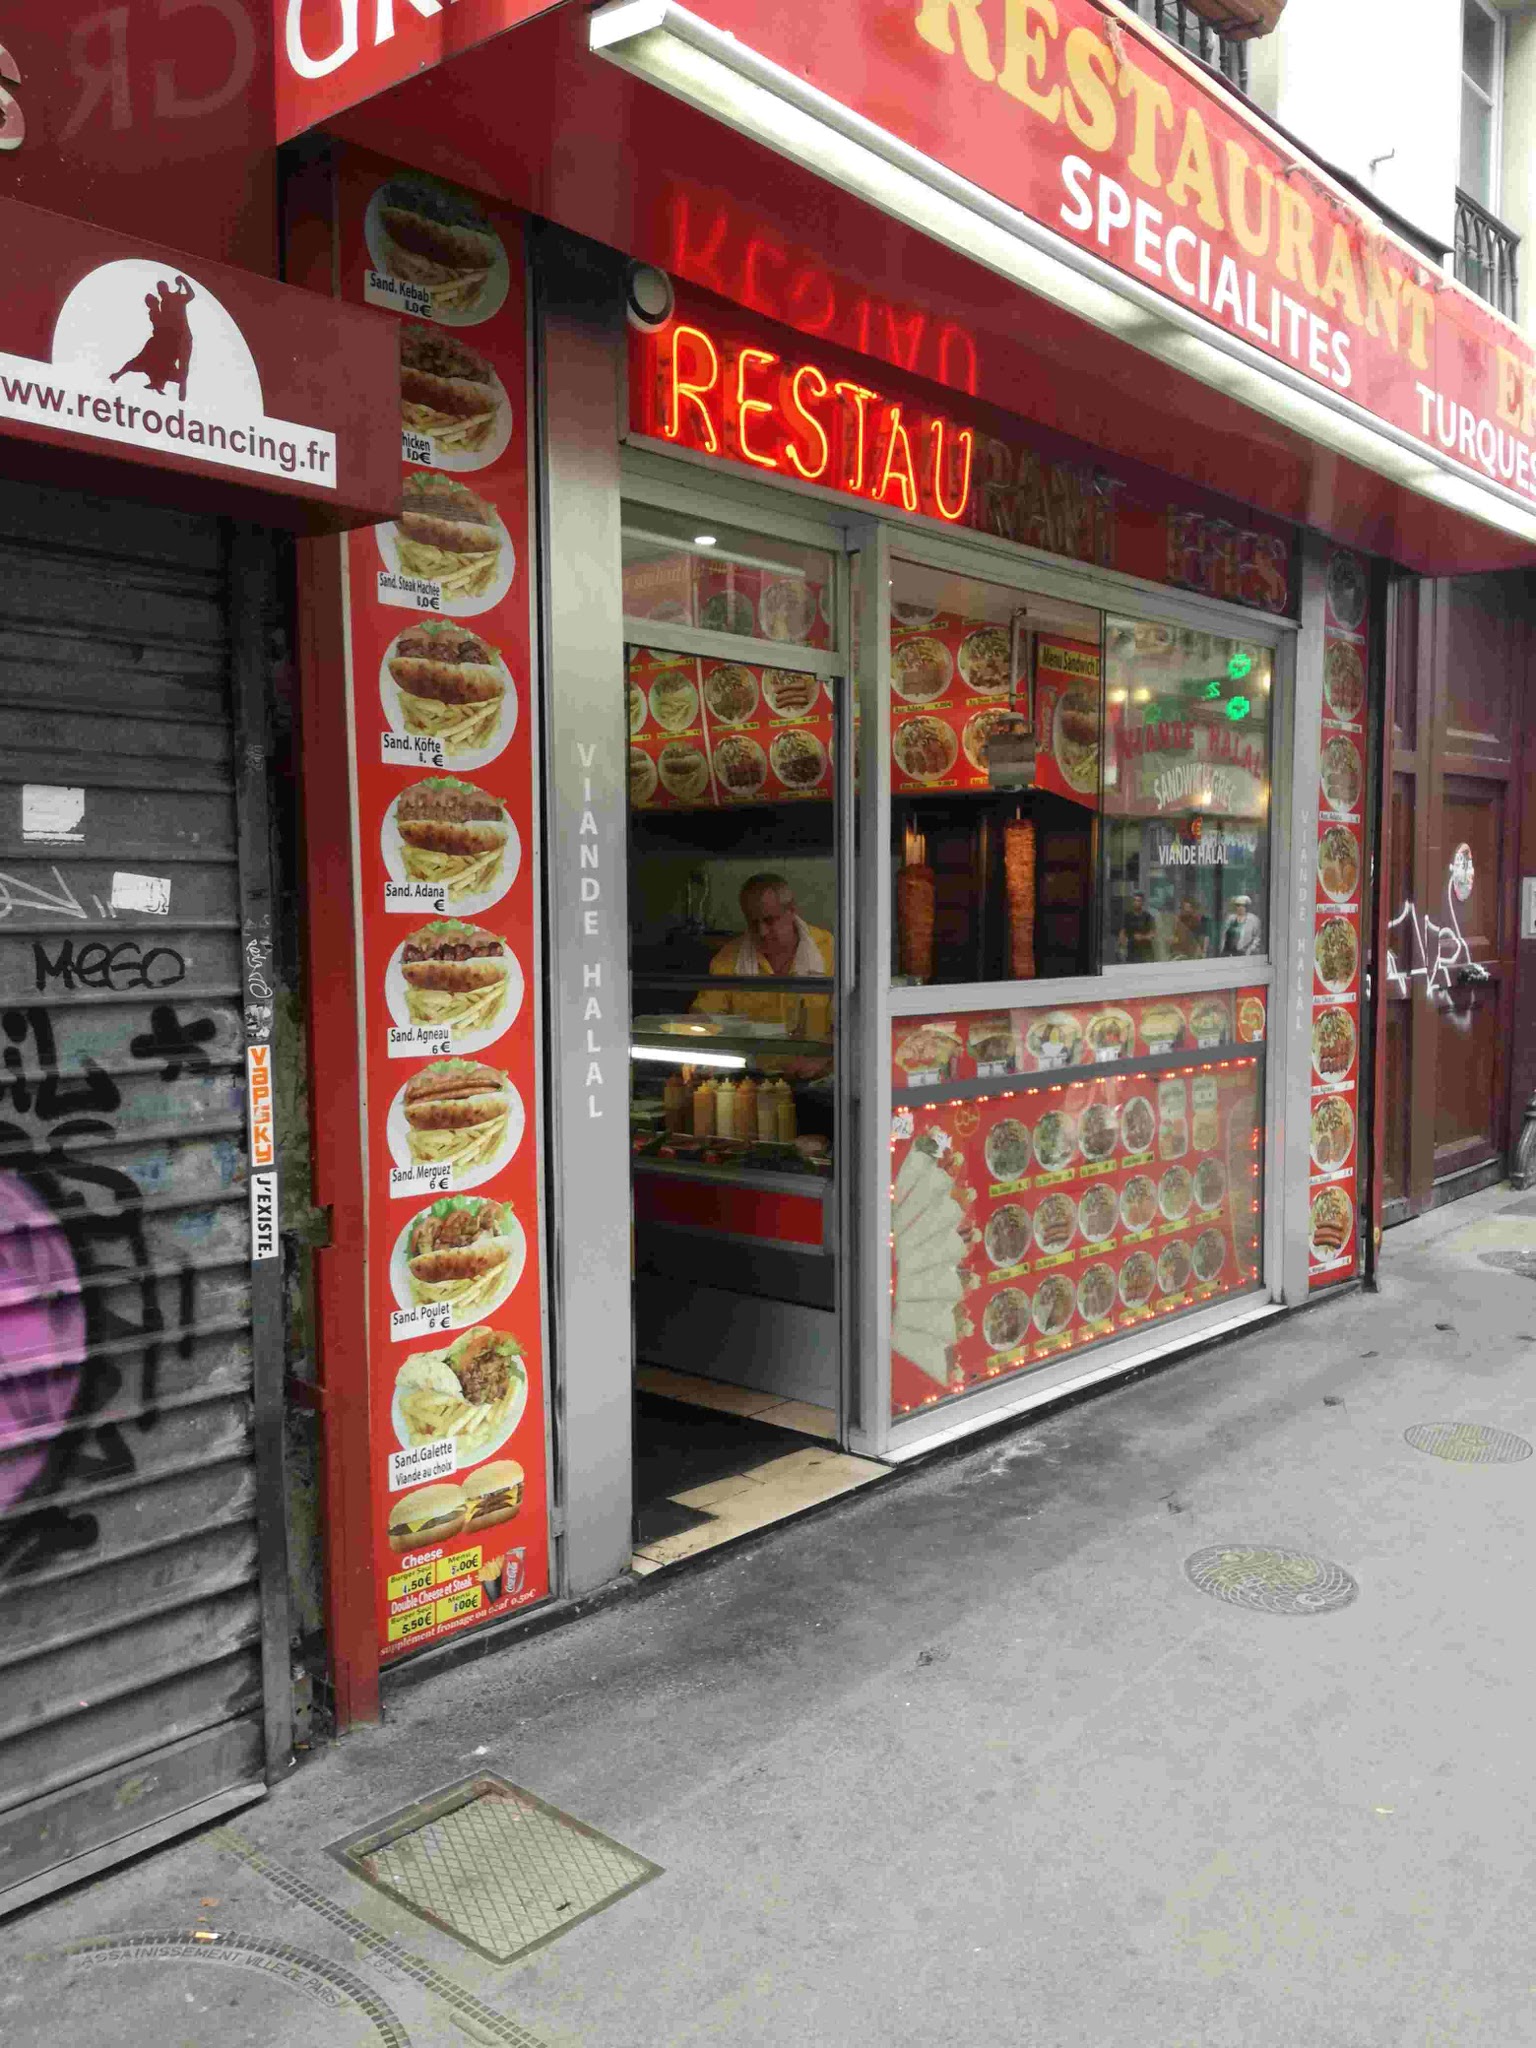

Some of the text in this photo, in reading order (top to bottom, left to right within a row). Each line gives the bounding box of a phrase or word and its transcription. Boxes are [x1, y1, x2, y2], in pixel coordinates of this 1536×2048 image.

[1060, 155, 1352, 388] SPECIALITES
[370, 272, 430, 303] Sand. Kebab
[402, 433, 431, 452] hicken
[379, 573, 398, 590] Sand.
[399, 576, 417, 593] Steak
[383, 734, 441, 754] Sand. Köfte
[1159, 845, 1229, 865] VIANDE HALAL
[385, 883, 445, 898] Sand. Adana
[577, 741, 603, 1119] VIANDE HALAL
[390, 1027, 449, 1043] Sand. Agneau
[392, 1164, 451, 1183] Sand. Merguez
[257, 1178, 273, 1258] J'EXISTE.
[393, 1302, 450, 1326] Sand. Poulet
[396, 1459, 453, 1487] Viande au choix
[402, 1548, 443, 1570] Cheese
[448, 1552, 471, 1564] Menu
[391, 1571, 415, 1584] Burger
[391, 1574, 472, 1615] Double Cheese et Steak
[448, 1592, 471, 1604] Menu
[391, 1612, 415, 1625] Burger
[402, 1611, 432, 1634] 5.50€
[380, 1627, 436, 1656] supplément
[436, 1613, 475, 1634] fromage
[82, 1944, 241, 1966] ASSAINISSEMENT
[245, 1954, 281, 1974] VILLE
[302, 1976, 341, 2004] PARIS
